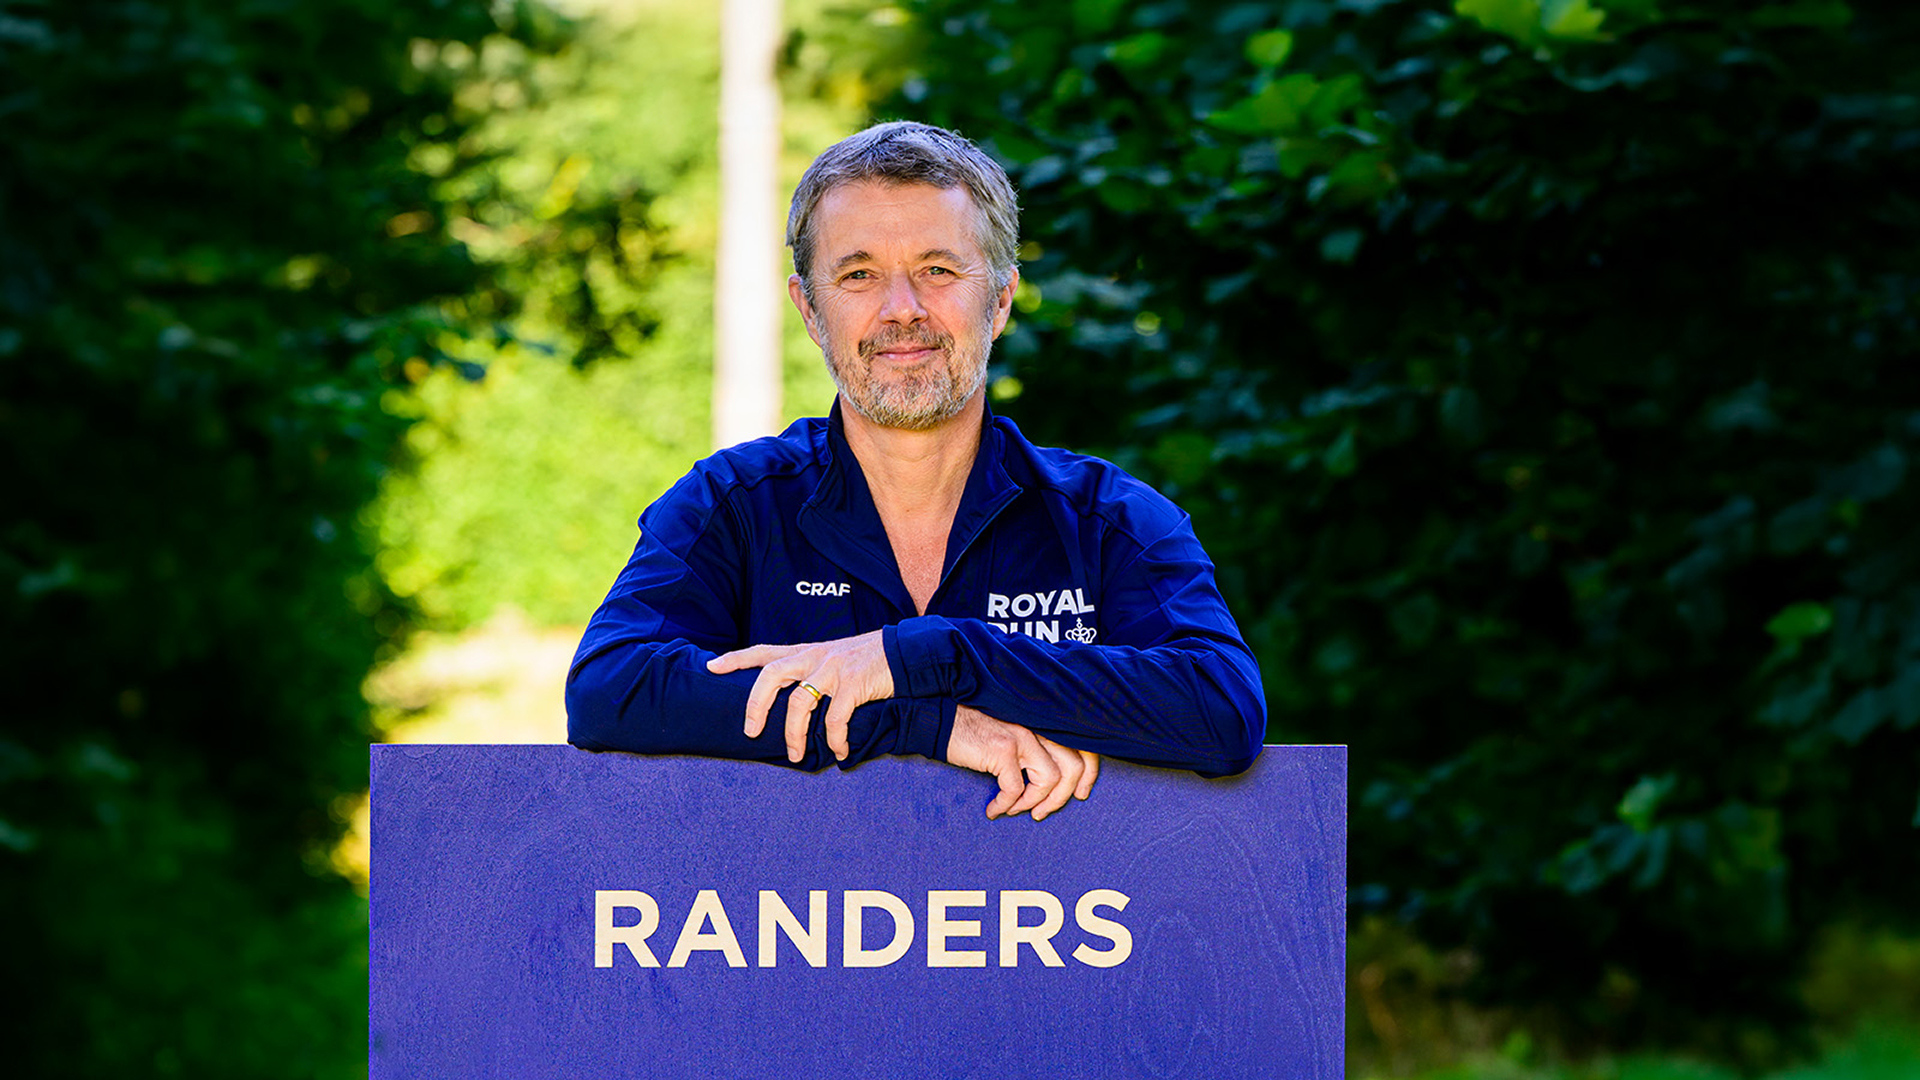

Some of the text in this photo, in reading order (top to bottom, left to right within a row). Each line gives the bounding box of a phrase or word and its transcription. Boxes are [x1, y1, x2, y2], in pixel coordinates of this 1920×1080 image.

[795, 581, 851, 597] CRAF
[987, 588, 1095, 618] ROYAL
[987, 620, 1060, 644] UN
[594, 888, 1133, 968] RANDERS
